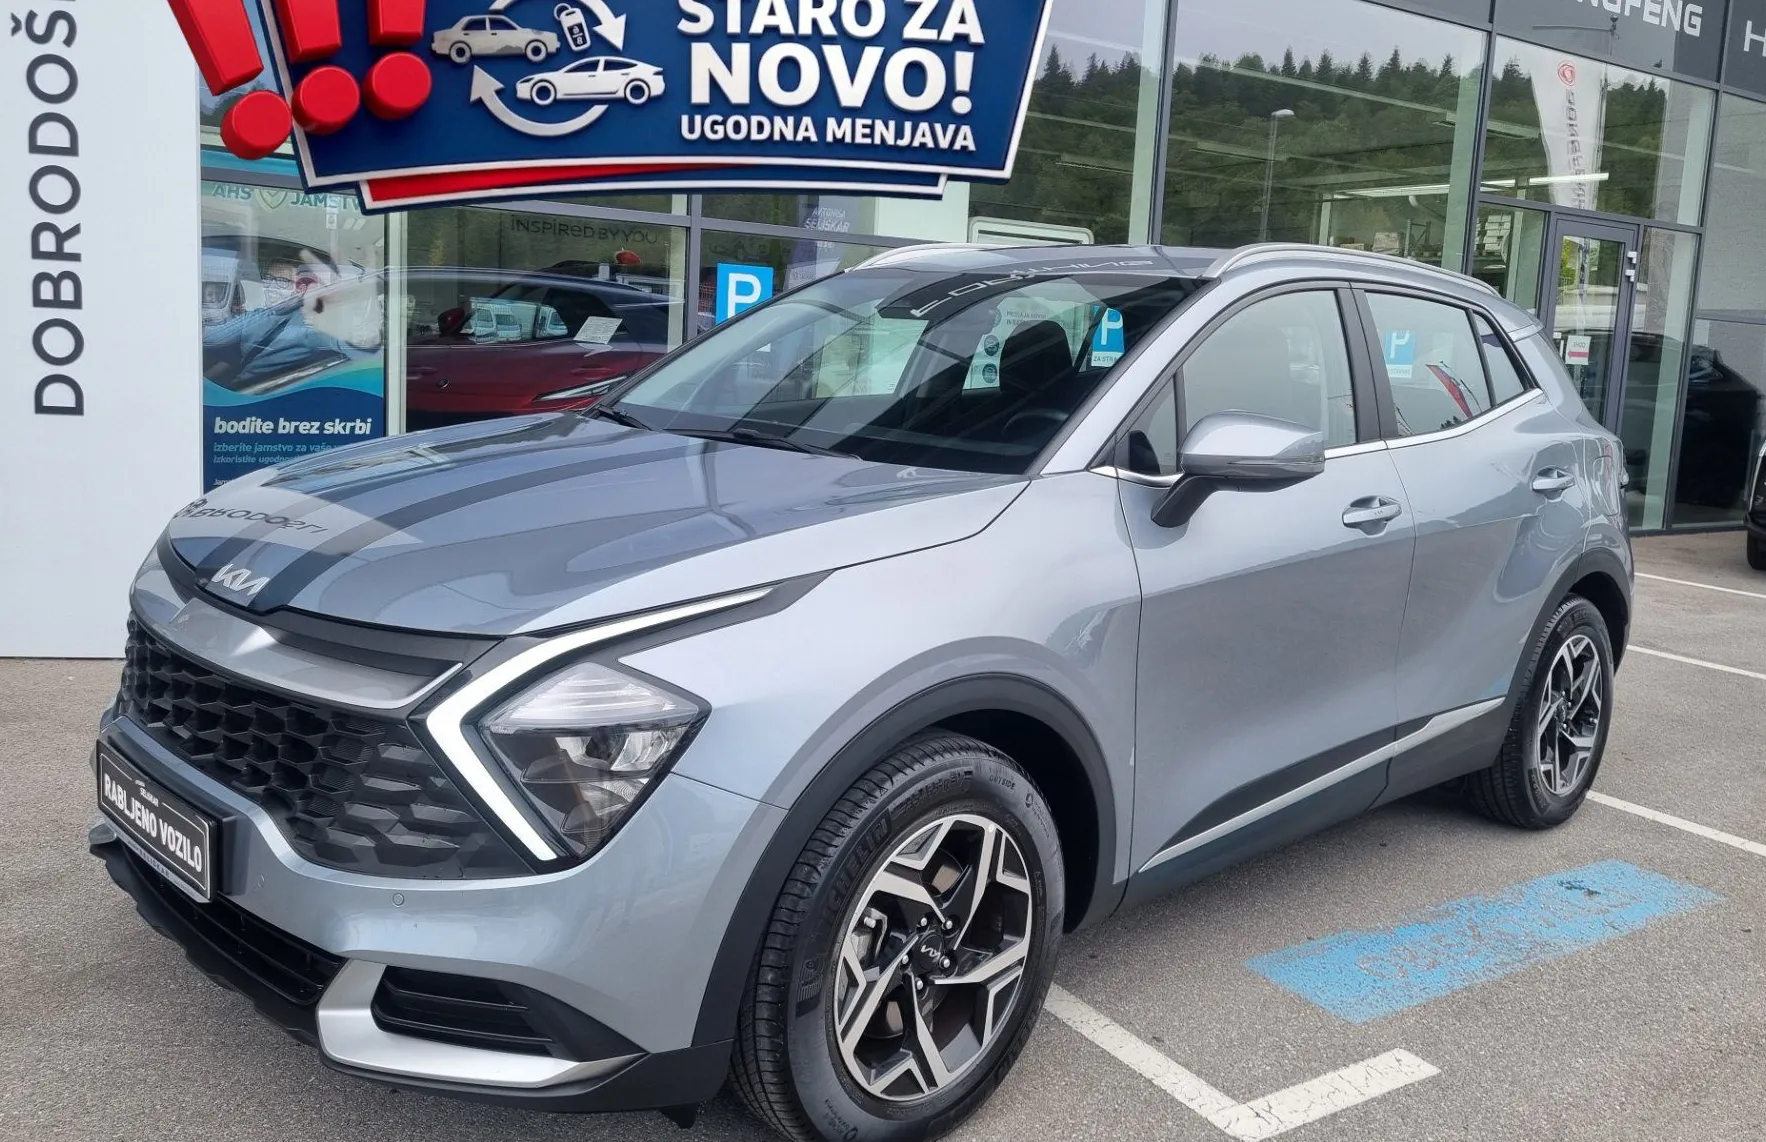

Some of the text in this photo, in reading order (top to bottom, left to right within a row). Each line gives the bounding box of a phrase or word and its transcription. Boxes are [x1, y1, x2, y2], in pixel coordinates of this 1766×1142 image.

[212, 184, 252, 200] AHS
[11, 0, 84, 416] DOBRODOŠ
[598, 228, 616, 241] BY
[622, 229, 658, 244] YOU
[214, 416, 372, 435] bodite brez skrbi
[213, 442, 251, 452] izberite
[253, 443, 293, 454] jamstvo
[295, 444, 307, 452] za
[211, 563, 270, 596] KIA
[104, 773, 203, 873] RABLJENO VOZILO
